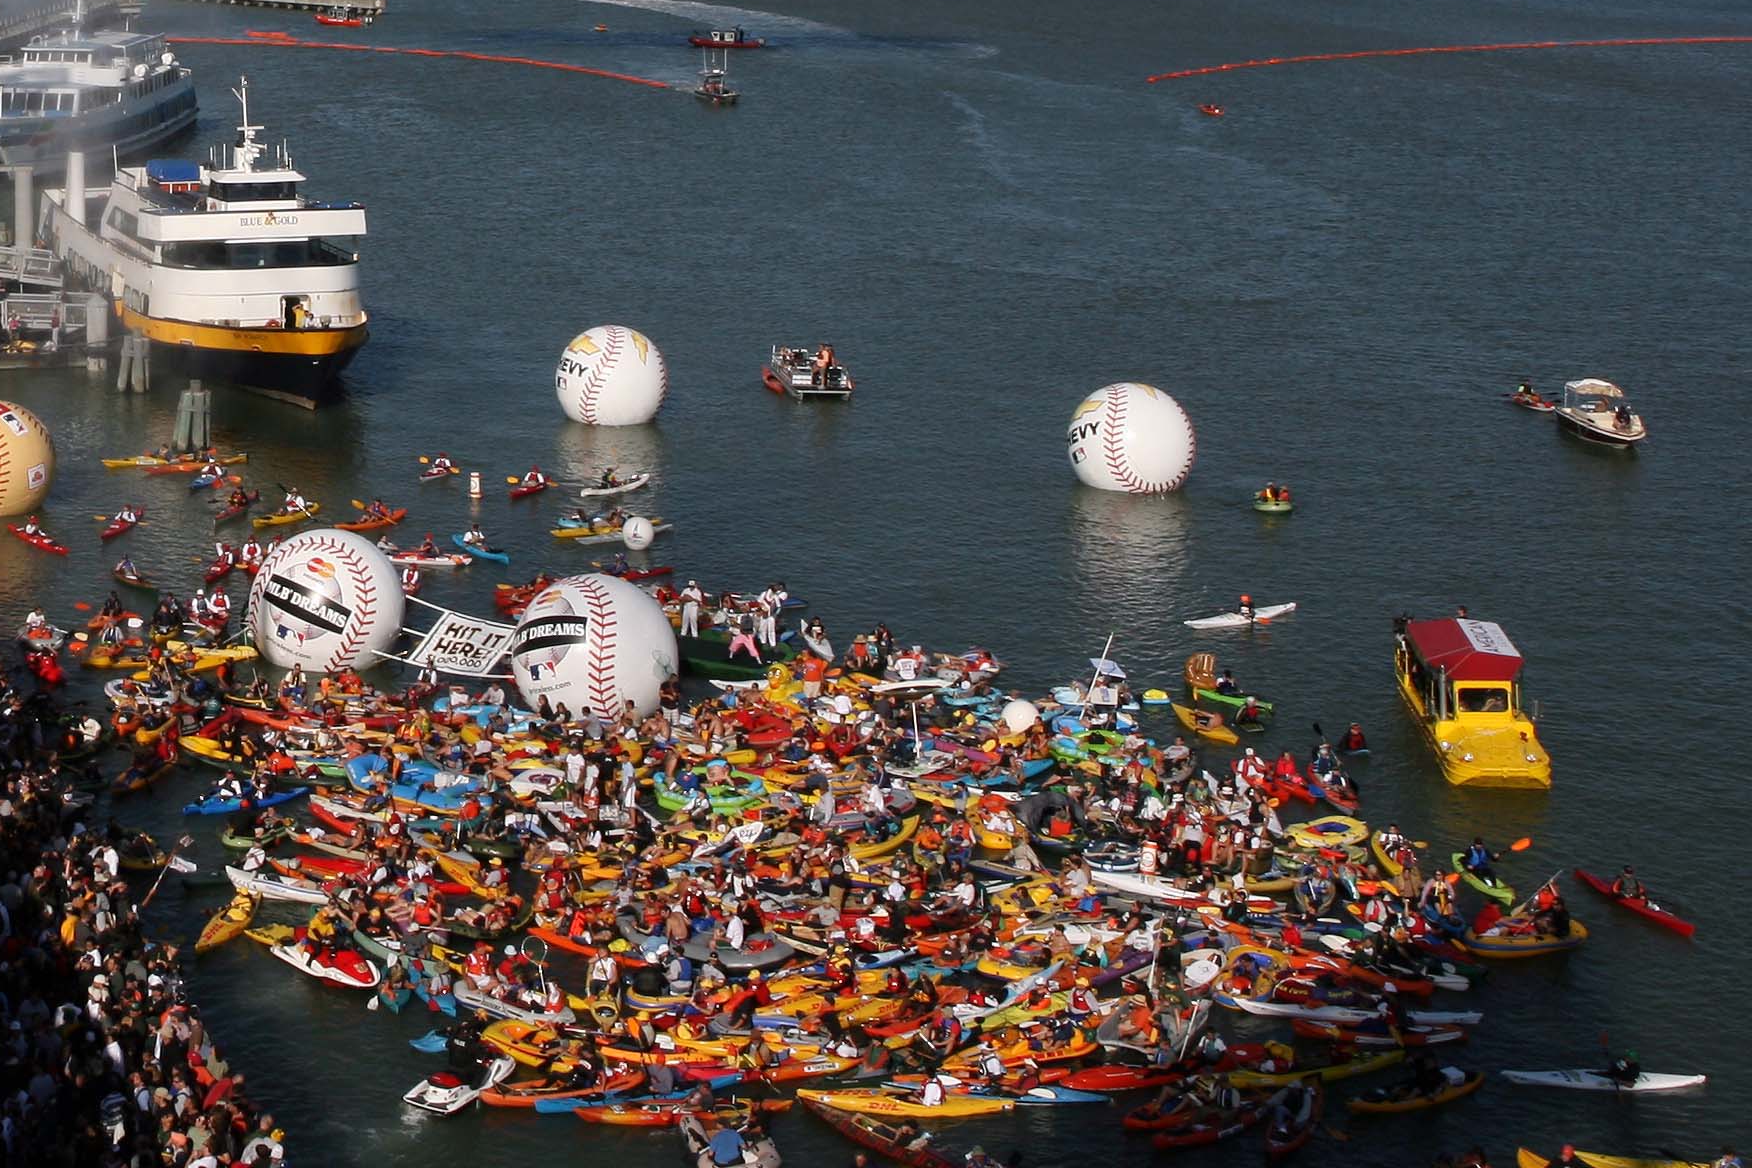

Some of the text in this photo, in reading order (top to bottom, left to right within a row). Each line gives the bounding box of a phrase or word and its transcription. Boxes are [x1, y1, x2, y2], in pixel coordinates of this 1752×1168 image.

[240, 216, 262, 226] BLUE
[274, 215, 298, 225] GOLD
[560, 357, 589, 377] EVY
[290, 590, 347, 628] DREAMS
[444, 622, 506, 648] HIT IT
[529, 623, 584, 642] DREAMS
[867, 1102, 900, 1112] DHL
